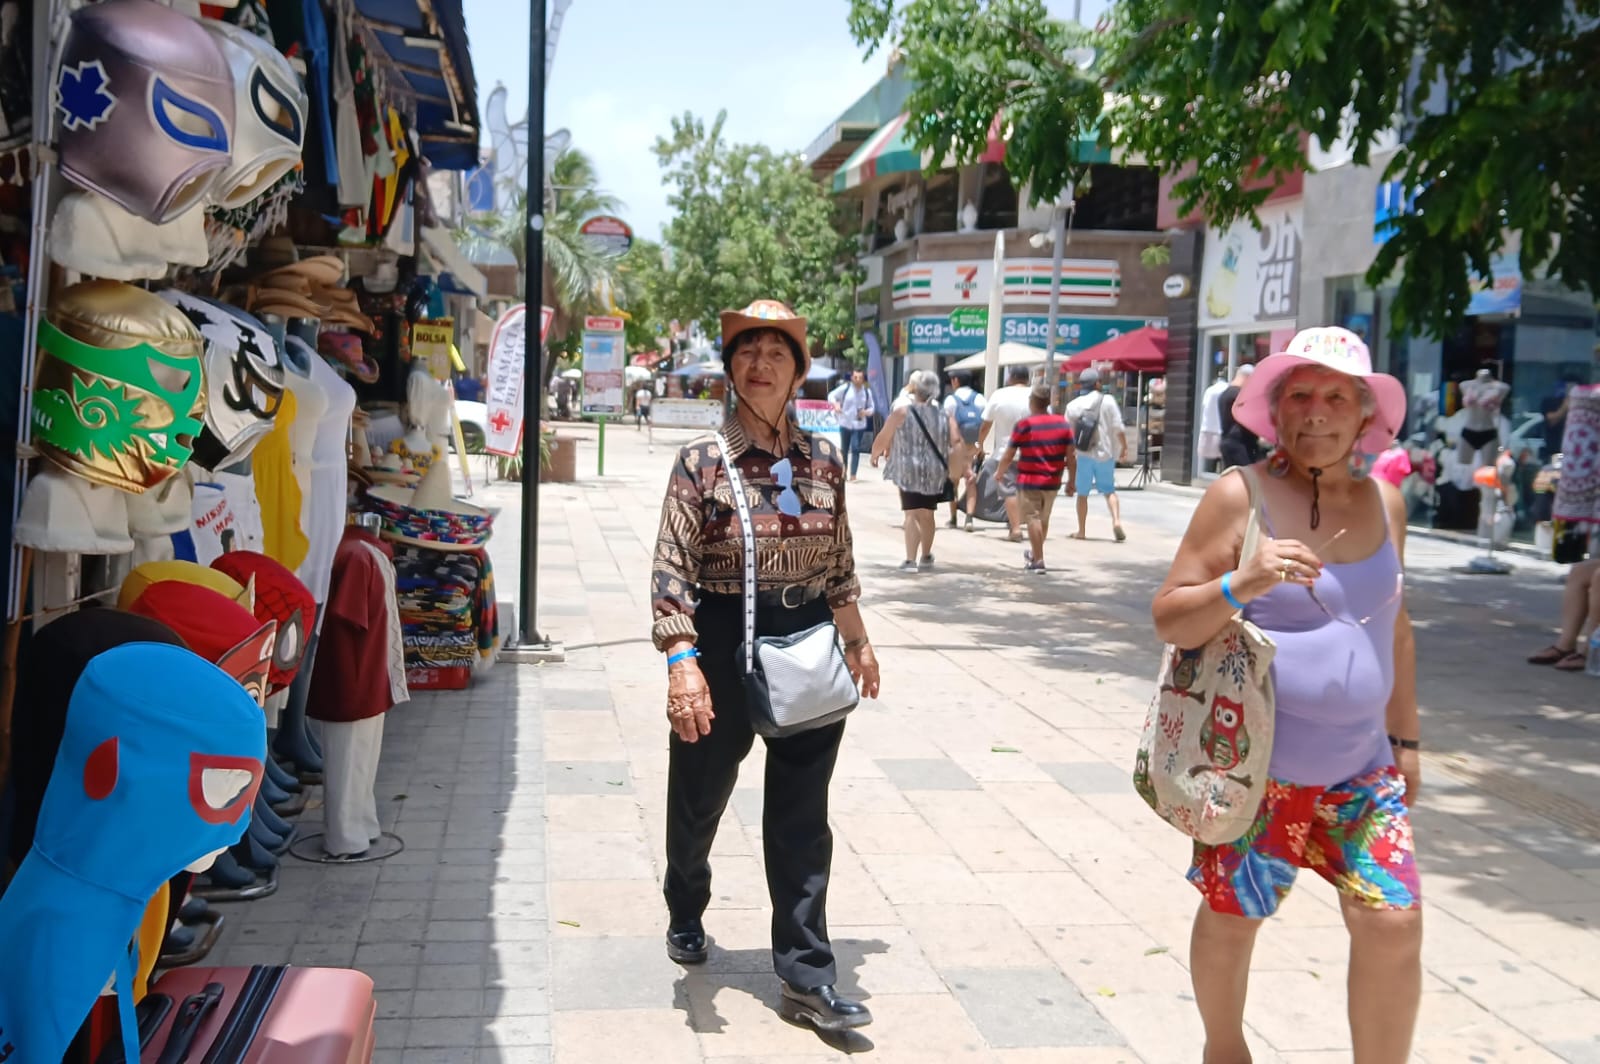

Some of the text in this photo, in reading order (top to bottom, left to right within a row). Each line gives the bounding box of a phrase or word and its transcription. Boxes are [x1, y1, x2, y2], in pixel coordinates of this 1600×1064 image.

[415, 331, 447, 344] BOLSA
[1004, 319, 1080, 338] Saboes
[493, 322, 522, 402] FARMACIA
